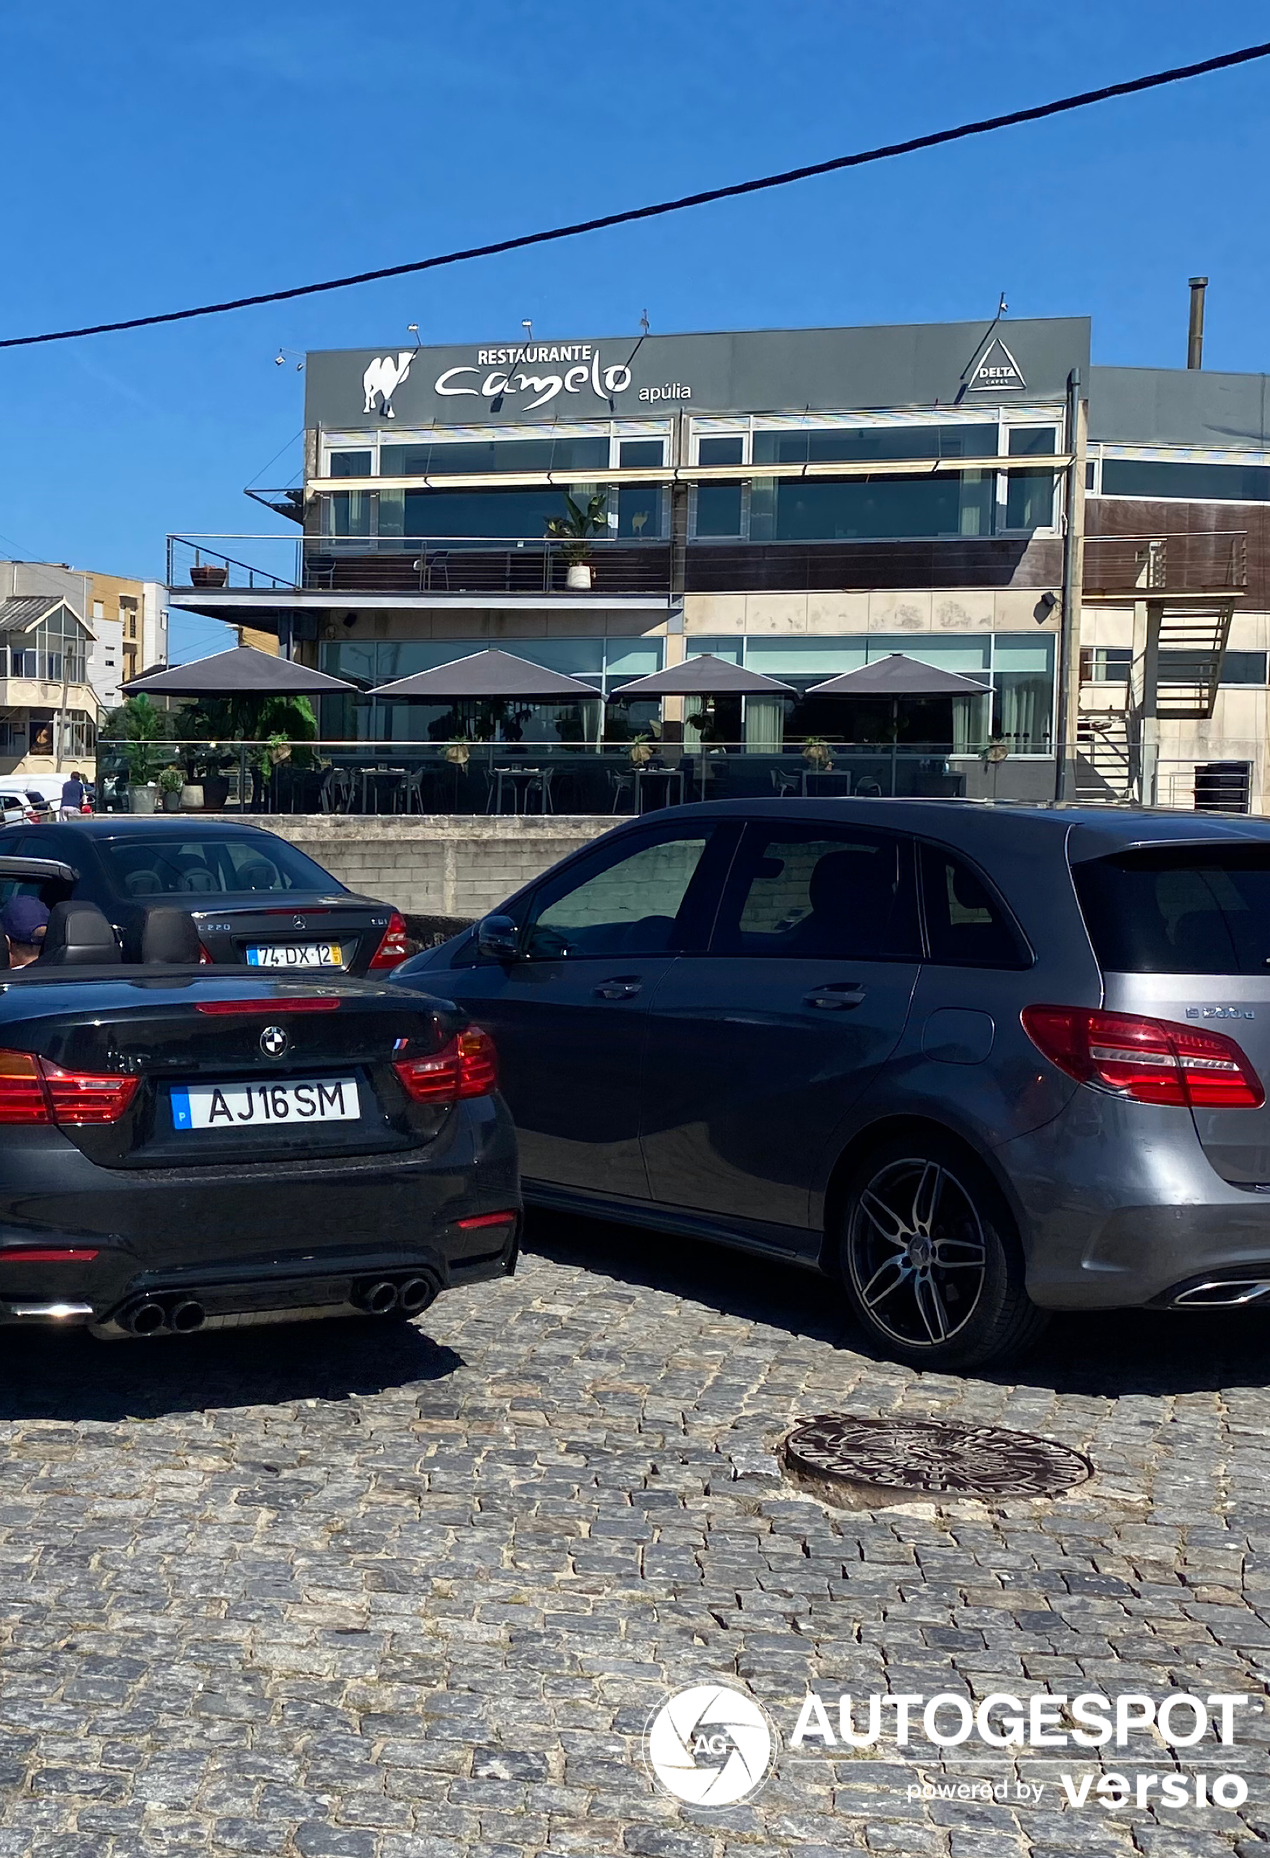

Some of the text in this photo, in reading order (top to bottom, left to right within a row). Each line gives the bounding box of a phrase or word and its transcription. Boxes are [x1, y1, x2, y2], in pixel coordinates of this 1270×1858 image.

[478, 345, 591, 365] RESTAURANTE
[979, 366, 1017, 379] DELTA
[639, 383, 692, 403] apúlia
[179, 1112, 186, 1122] P
